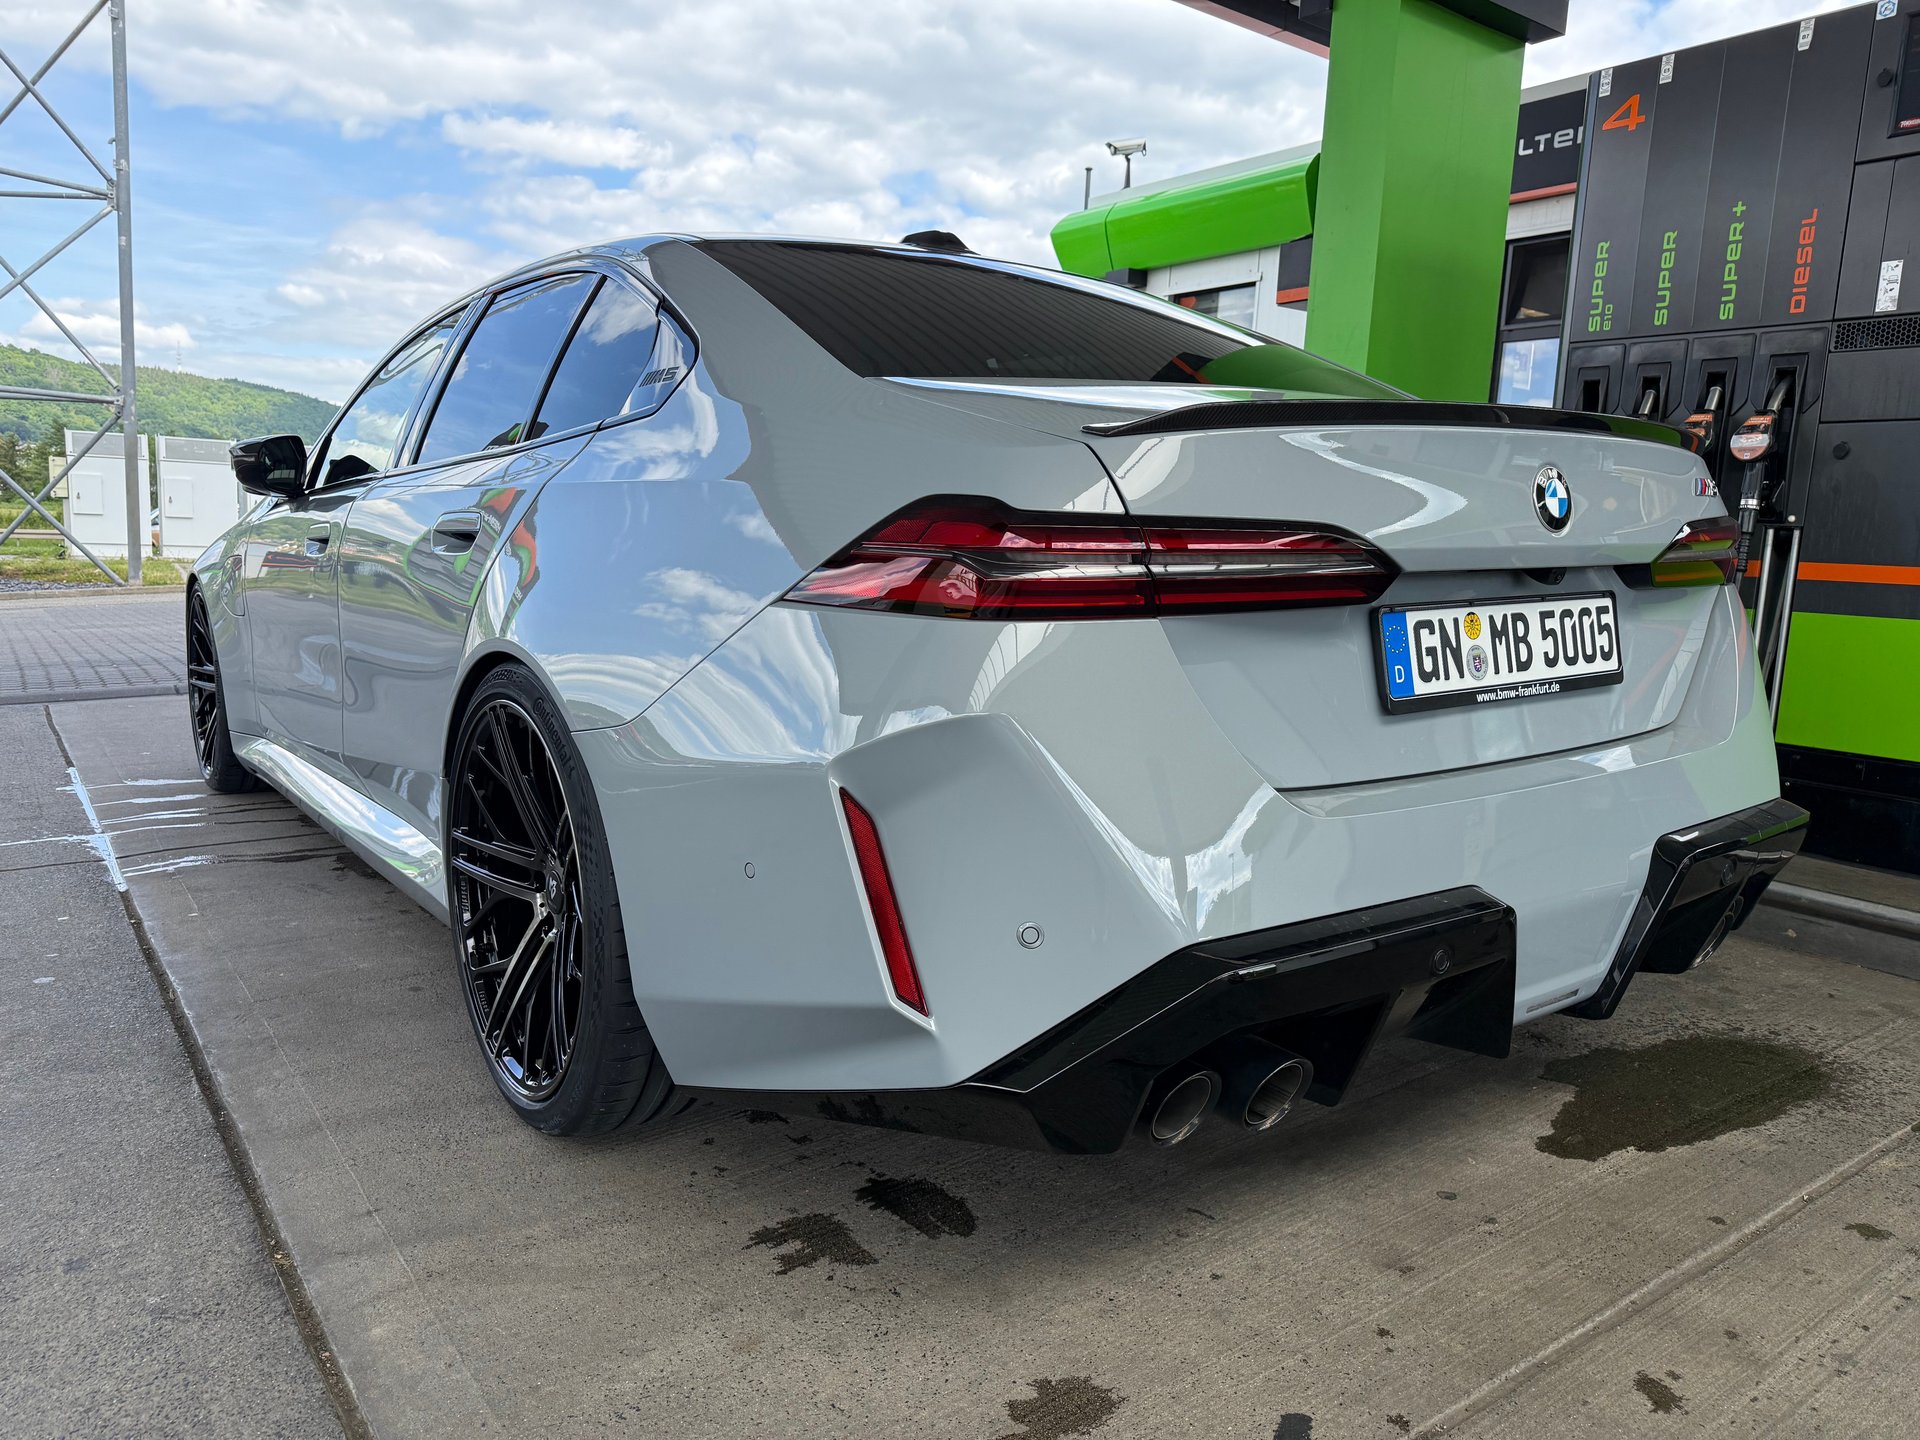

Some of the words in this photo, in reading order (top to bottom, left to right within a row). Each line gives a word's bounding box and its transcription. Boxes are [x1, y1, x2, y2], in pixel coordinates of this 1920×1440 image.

[1602, 94, 1646, 132] 4
[1518, 126, 1584, 156] LTE
[1588, 240, 1610, 332] SUPER
[1654, 230, 1678, 326] SUPER
[1537, 468, 1567, 488] BMW
[1413, 617, 1465, 683] GN
[1488, 612, 1533, 675] MB
[1539, 605, 1613, 668] 5005
[1395, 665, 1405, 683] D
[1476, 682, 1560, 703] www.bmw-frankfurt.de
[533, 697, 572, 767] Continental
